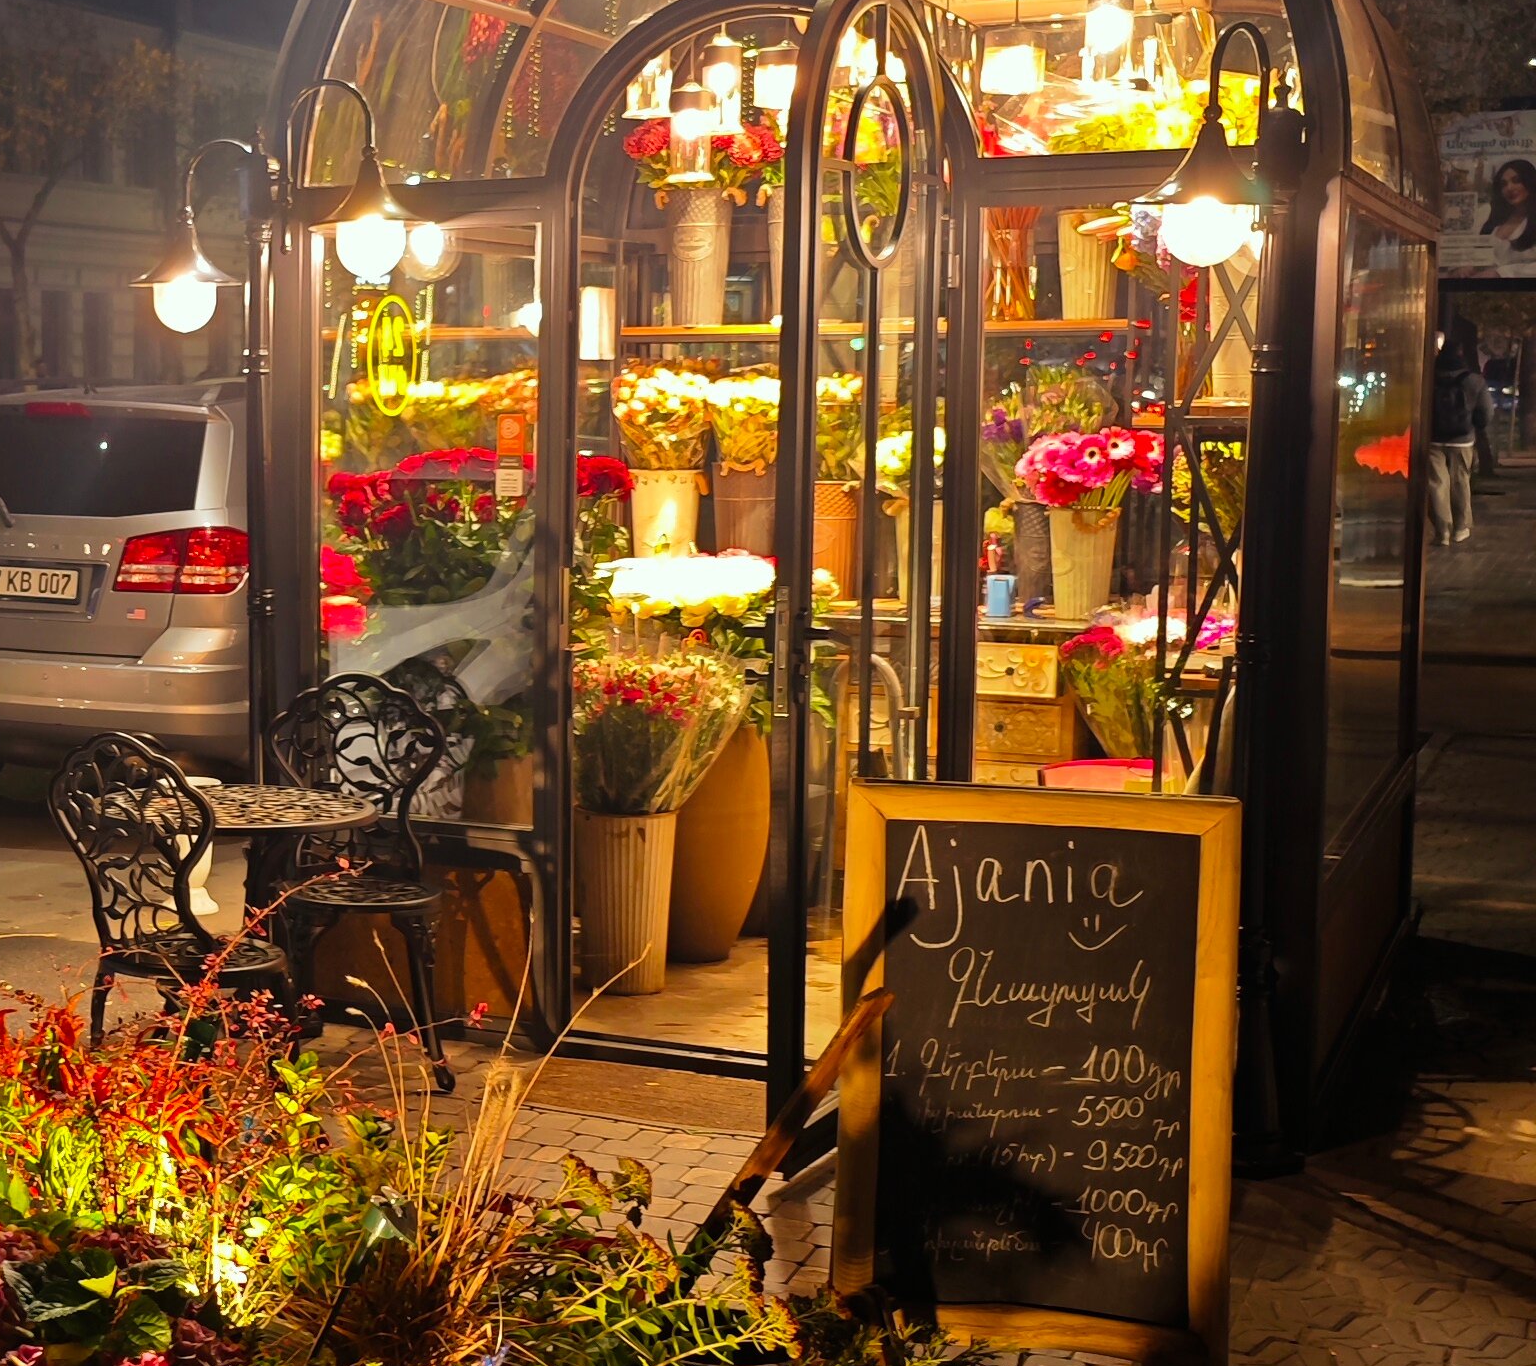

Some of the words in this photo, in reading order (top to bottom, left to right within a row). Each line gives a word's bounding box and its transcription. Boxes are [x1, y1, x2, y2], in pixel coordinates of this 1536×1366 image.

[7, 571, 32, 593] KB
[38, 573, 72, 595] 007
[896, 825, 1143, 948] Ajania
